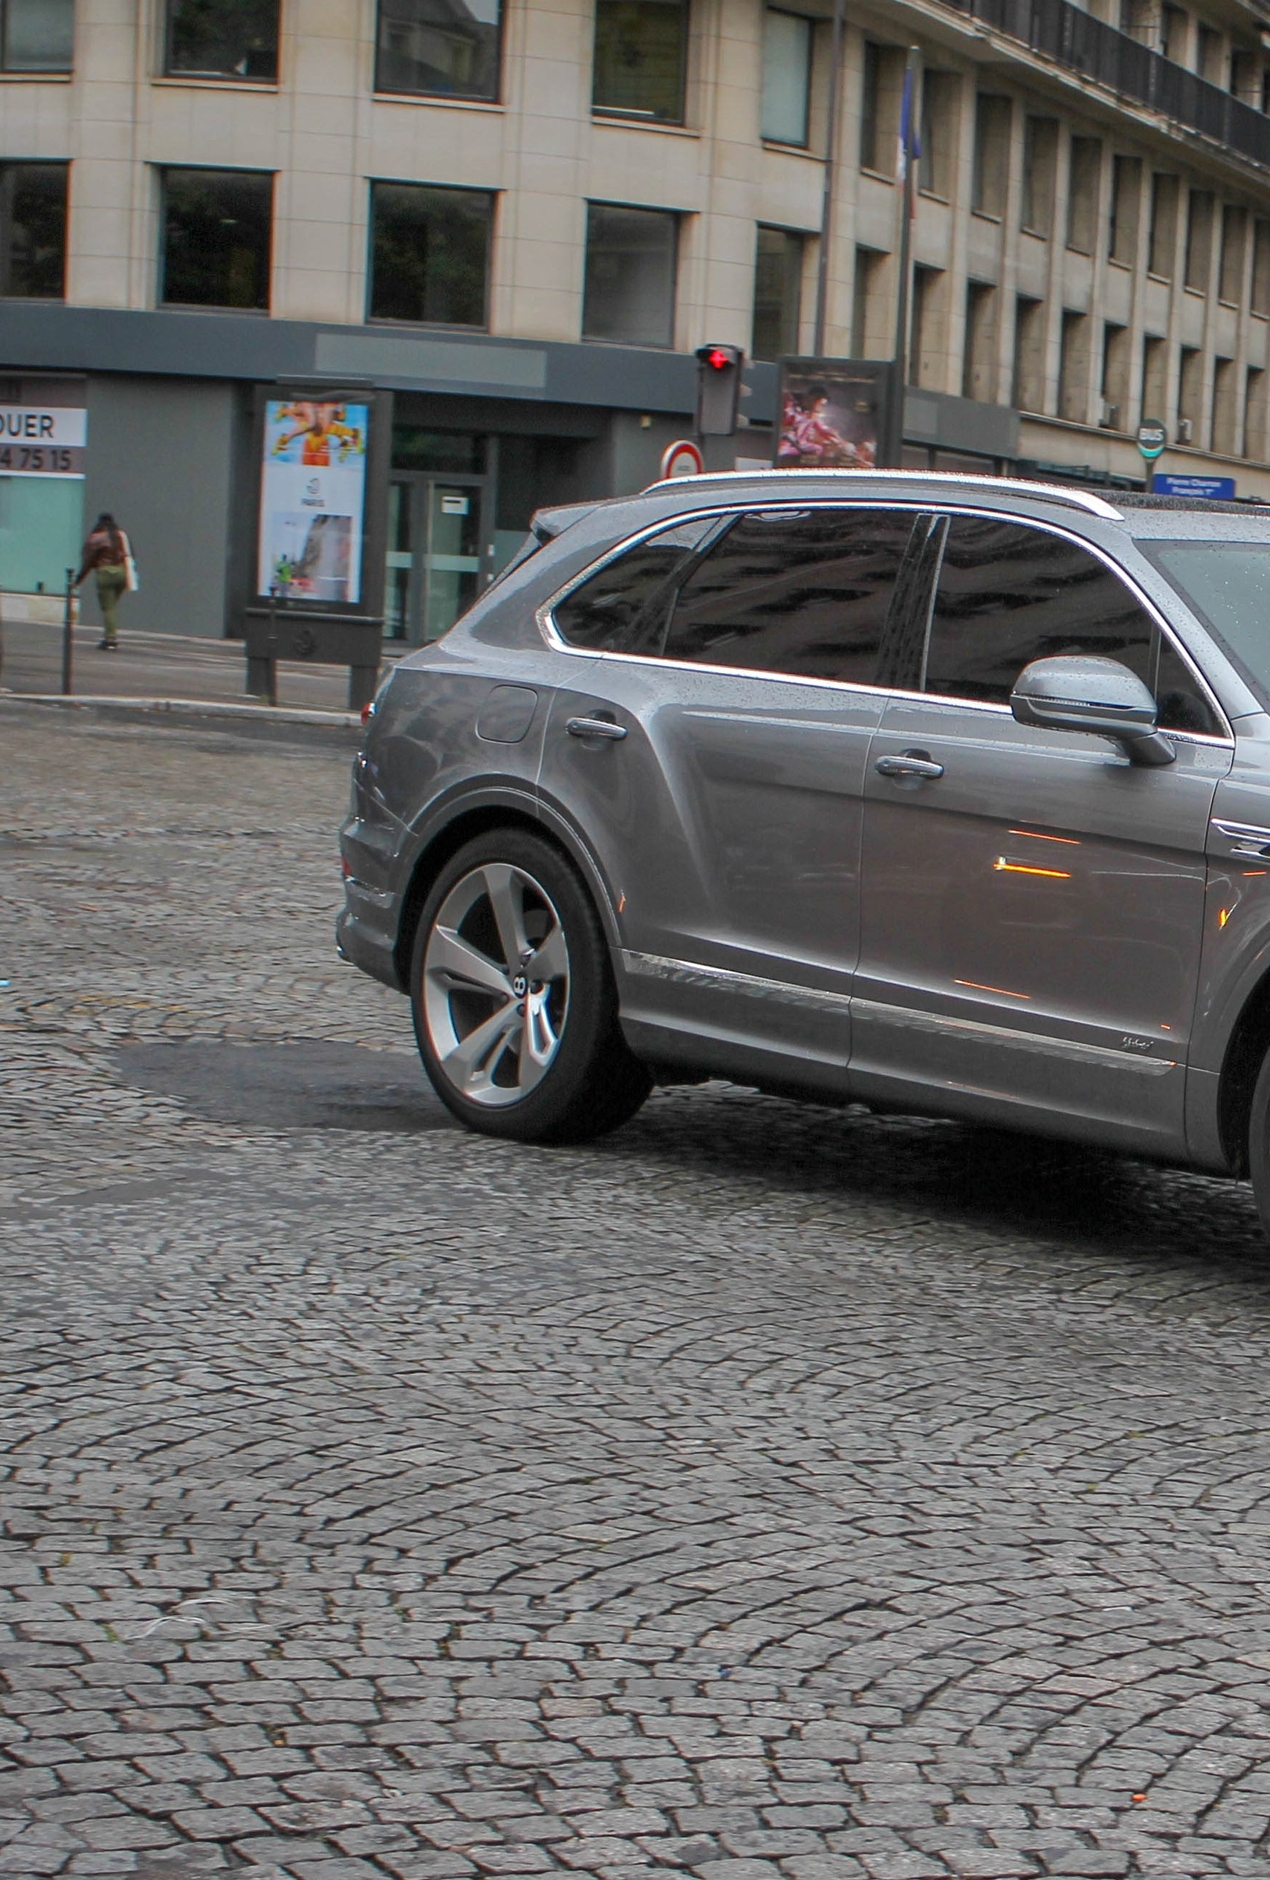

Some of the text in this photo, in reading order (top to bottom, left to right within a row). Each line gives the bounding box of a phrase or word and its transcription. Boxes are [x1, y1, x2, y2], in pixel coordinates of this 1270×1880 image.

[1140, 428, 1164, 441] BUS
[21, 447, 43, 470] 75
[51, 449, 71, 471] 15
